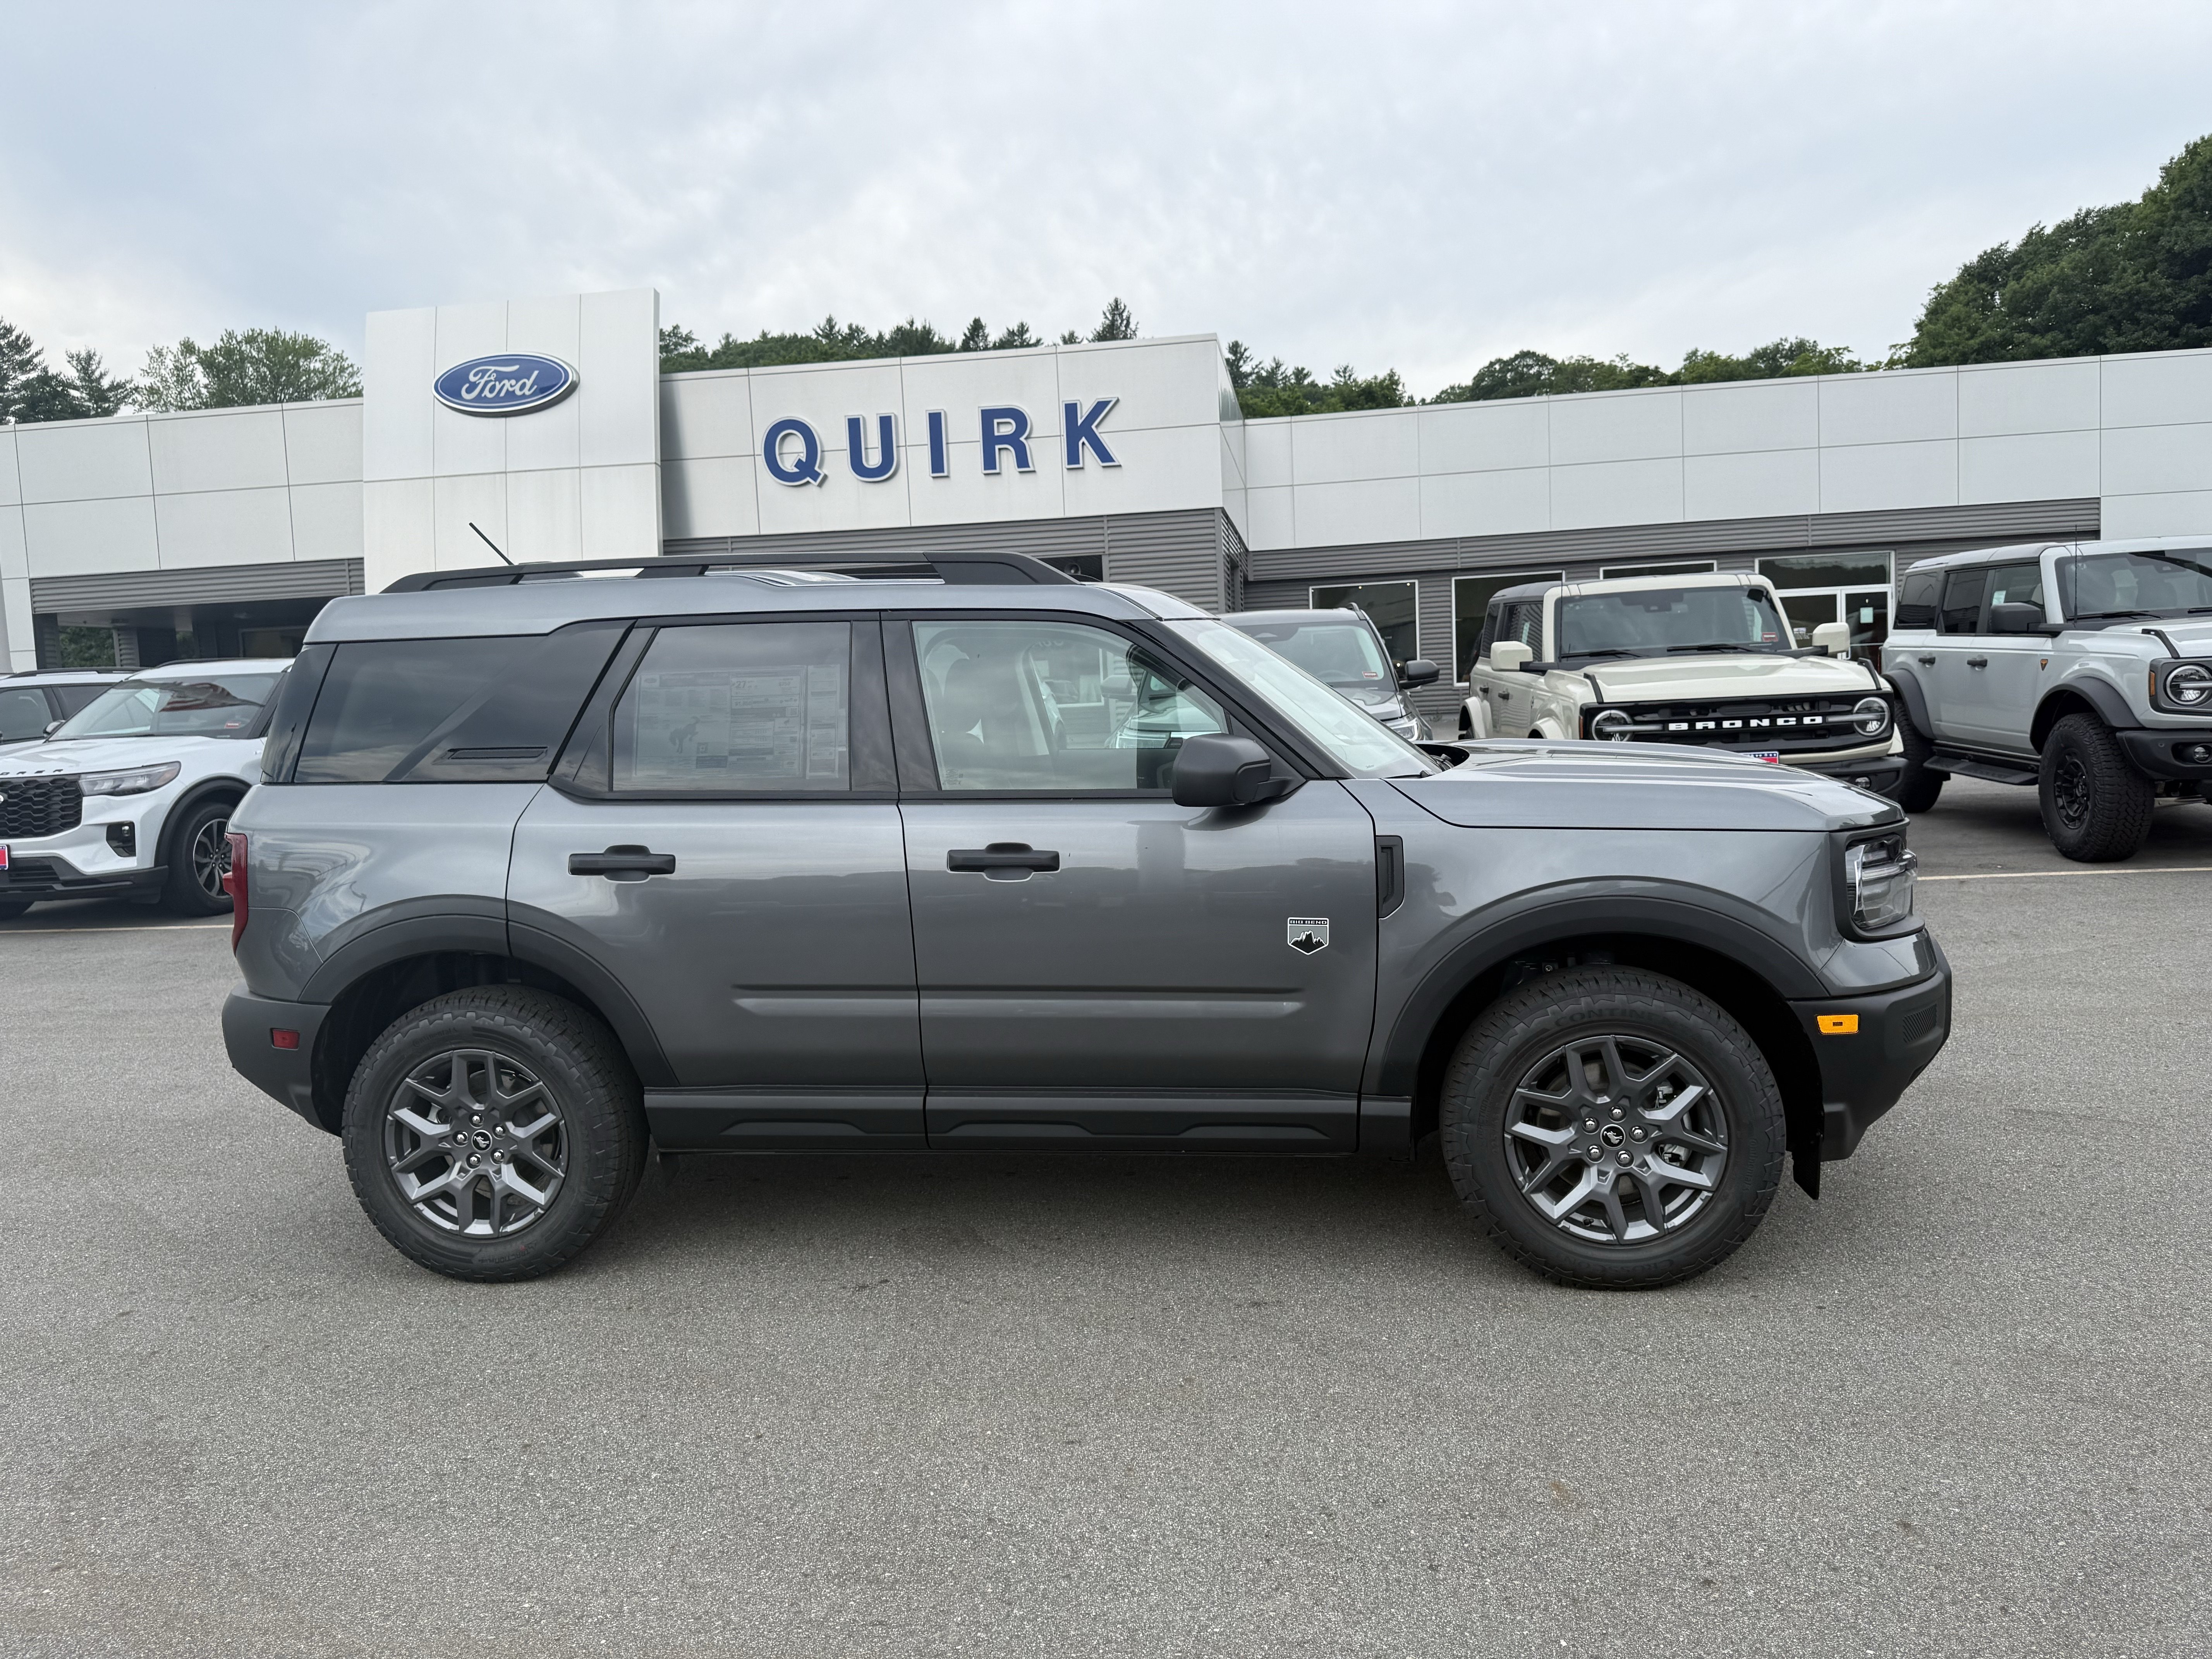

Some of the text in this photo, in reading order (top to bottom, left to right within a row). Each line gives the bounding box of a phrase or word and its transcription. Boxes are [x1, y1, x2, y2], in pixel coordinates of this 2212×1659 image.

[461, 365, 539, 400] Ford
[761, 397, 1121, 486] QUIRK
[1668, 716, 1823, 731] BRONCO
